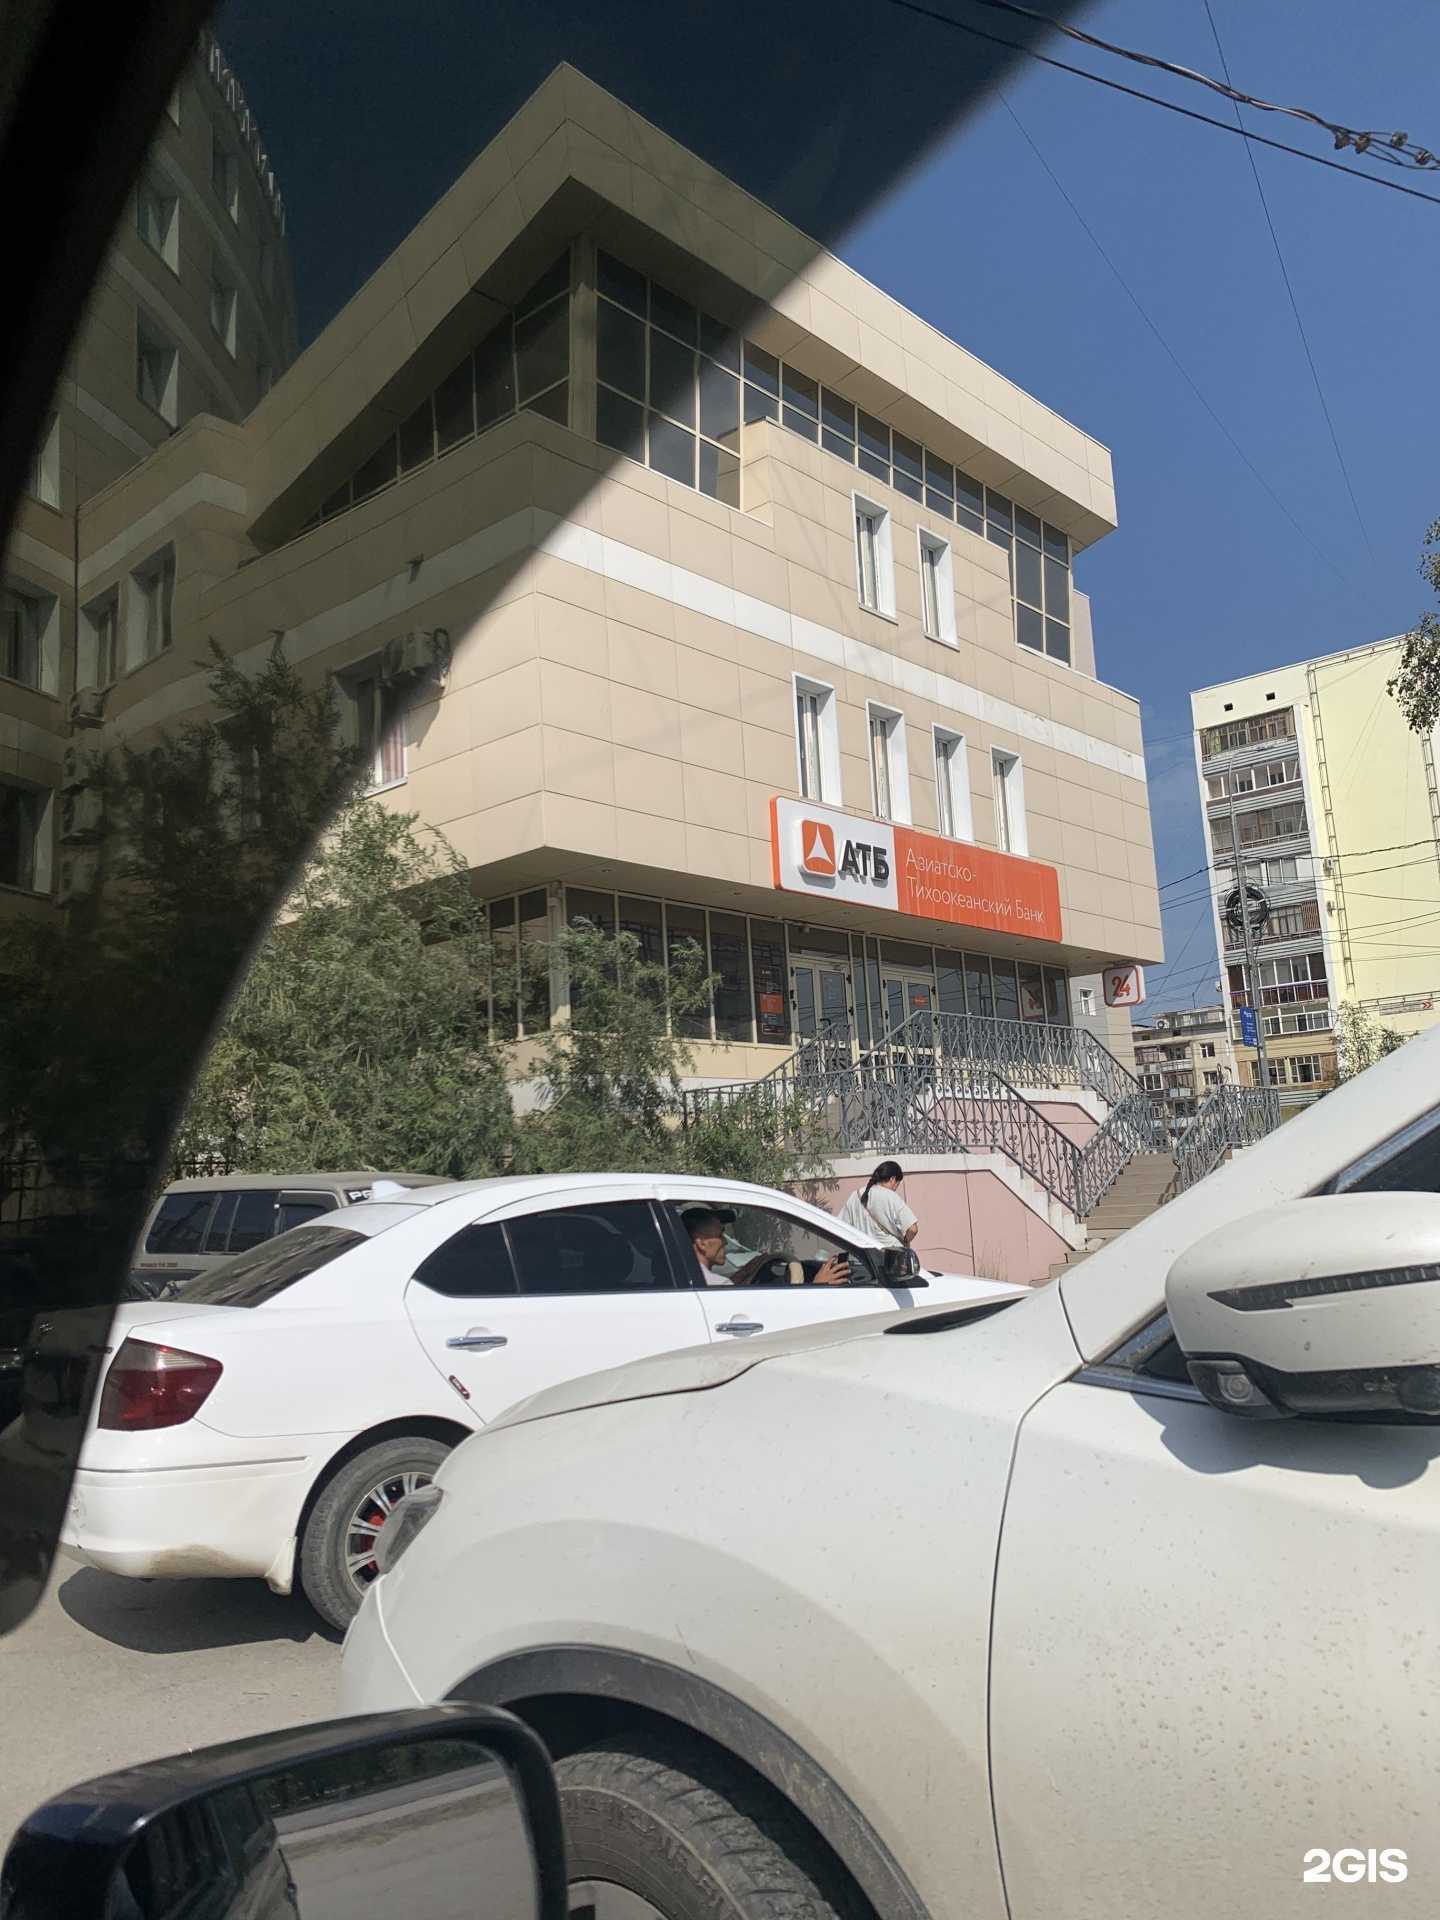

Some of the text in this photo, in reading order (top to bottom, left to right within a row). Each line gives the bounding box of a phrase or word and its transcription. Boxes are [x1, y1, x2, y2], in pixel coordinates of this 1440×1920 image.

[839, 839, 889, 881] АТБ
[905, 847, 977, 882] Азиатско-
[905, 875, 1045, 923] Тихоокеанский Банк
[1111, 975, 1131, 997] 24
